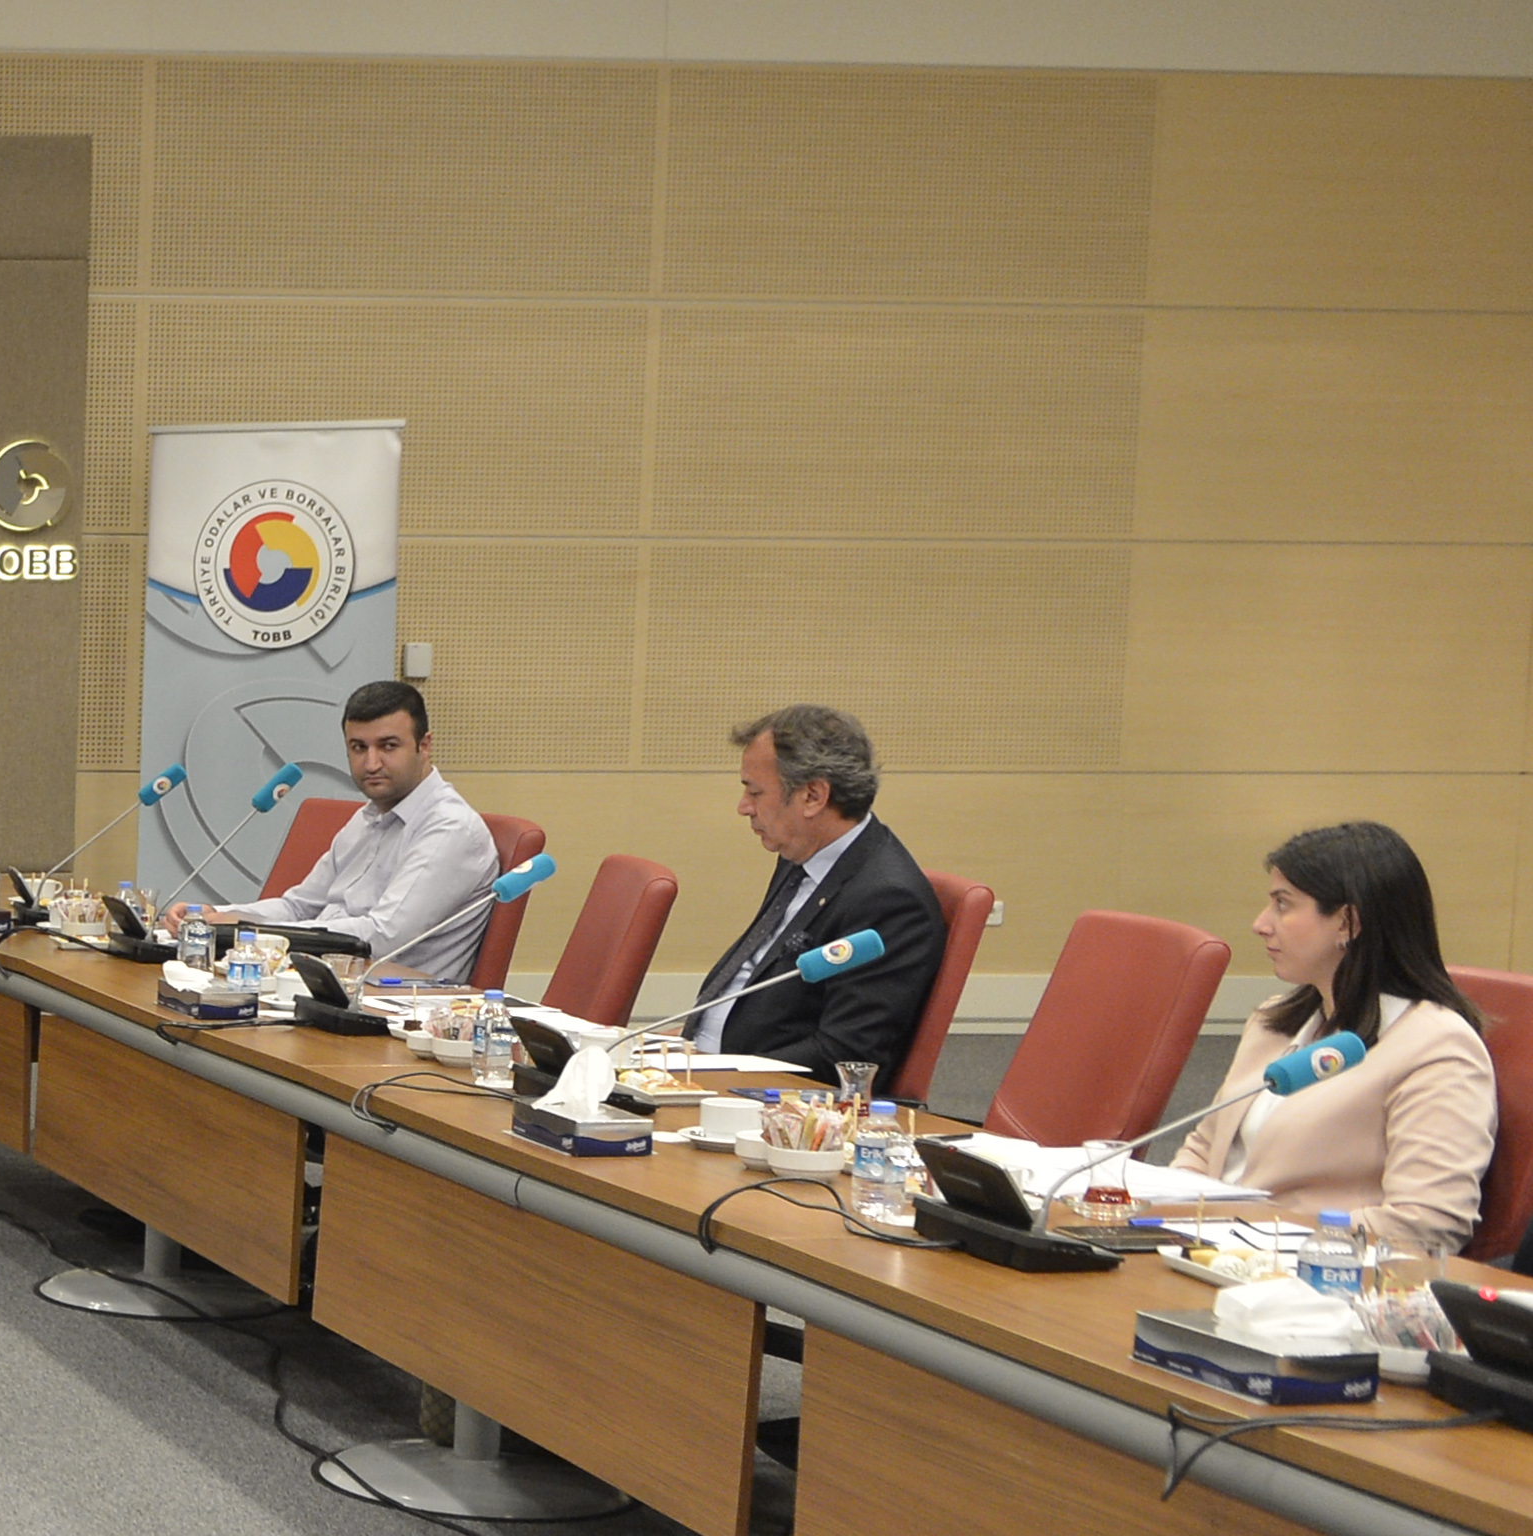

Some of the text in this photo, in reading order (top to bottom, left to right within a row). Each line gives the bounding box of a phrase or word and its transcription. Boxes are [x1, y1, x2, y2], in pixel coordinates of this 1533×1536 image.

[204, 494, 252, 548] ODALAR
[258, 487, 278, 499] VE
[285, 489, 345, 557] BORSALAR
[252, 629, 293, 642] TOBB
